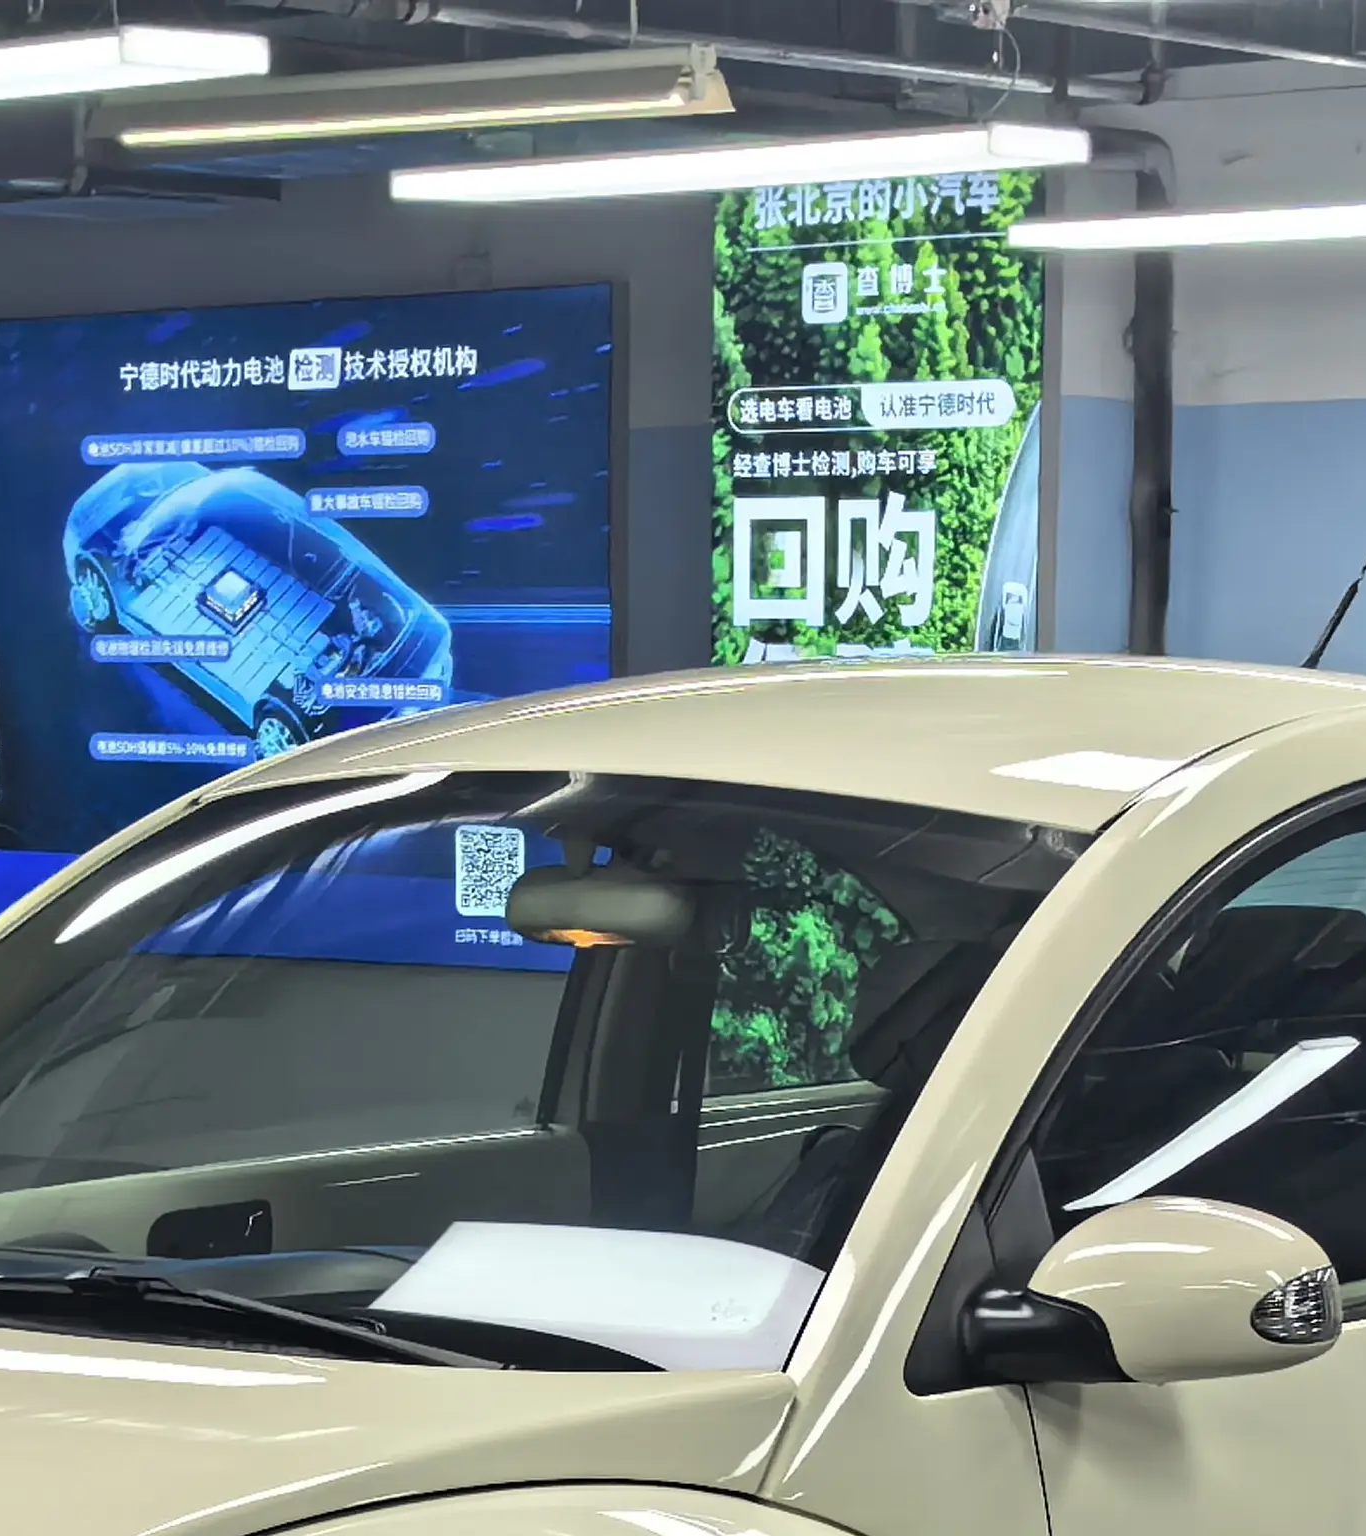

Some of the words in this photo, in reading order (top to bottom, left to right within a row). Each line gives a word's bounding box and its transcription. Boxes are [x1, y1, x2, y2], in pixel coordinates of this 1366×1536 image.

[753, 170, 1001, 230] 张北京的小汽车
[856, 263, 948, 298] 查博士
[739, 395, 853, 423] 选电车看电池
[879, 391, 997, 418] 认准宁德时代
[733, 493, 938, 630] 回购
